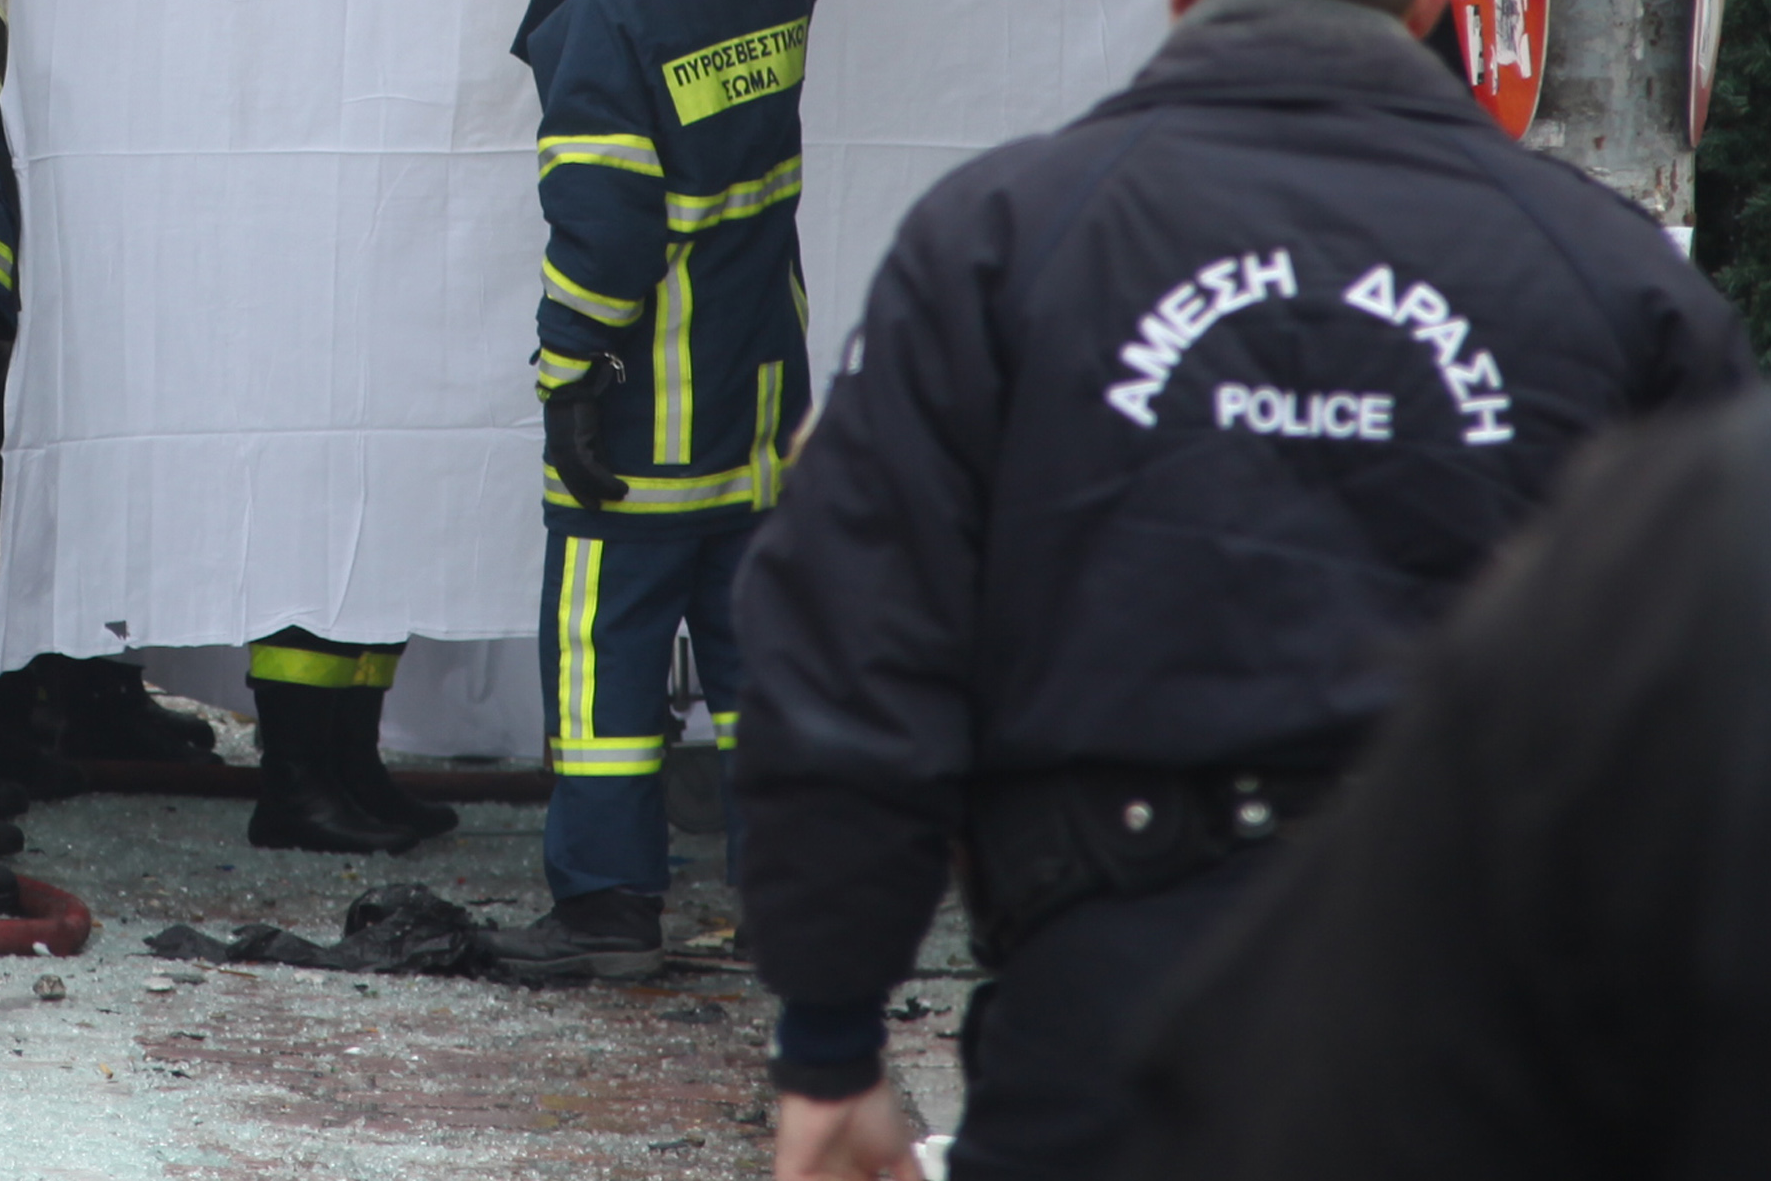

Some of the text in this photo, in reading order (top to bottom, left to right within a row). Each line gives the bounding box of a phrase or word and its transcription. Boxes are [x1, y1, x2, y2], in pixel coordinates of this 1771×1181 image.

[722, 67, 781, 101] ΣΩΜΑ
[1106, 247, 1514, 443] ΑΜΕΣΗ ΔΡΑΣΗ
[1214, 381, 1395, 439] POLICE
